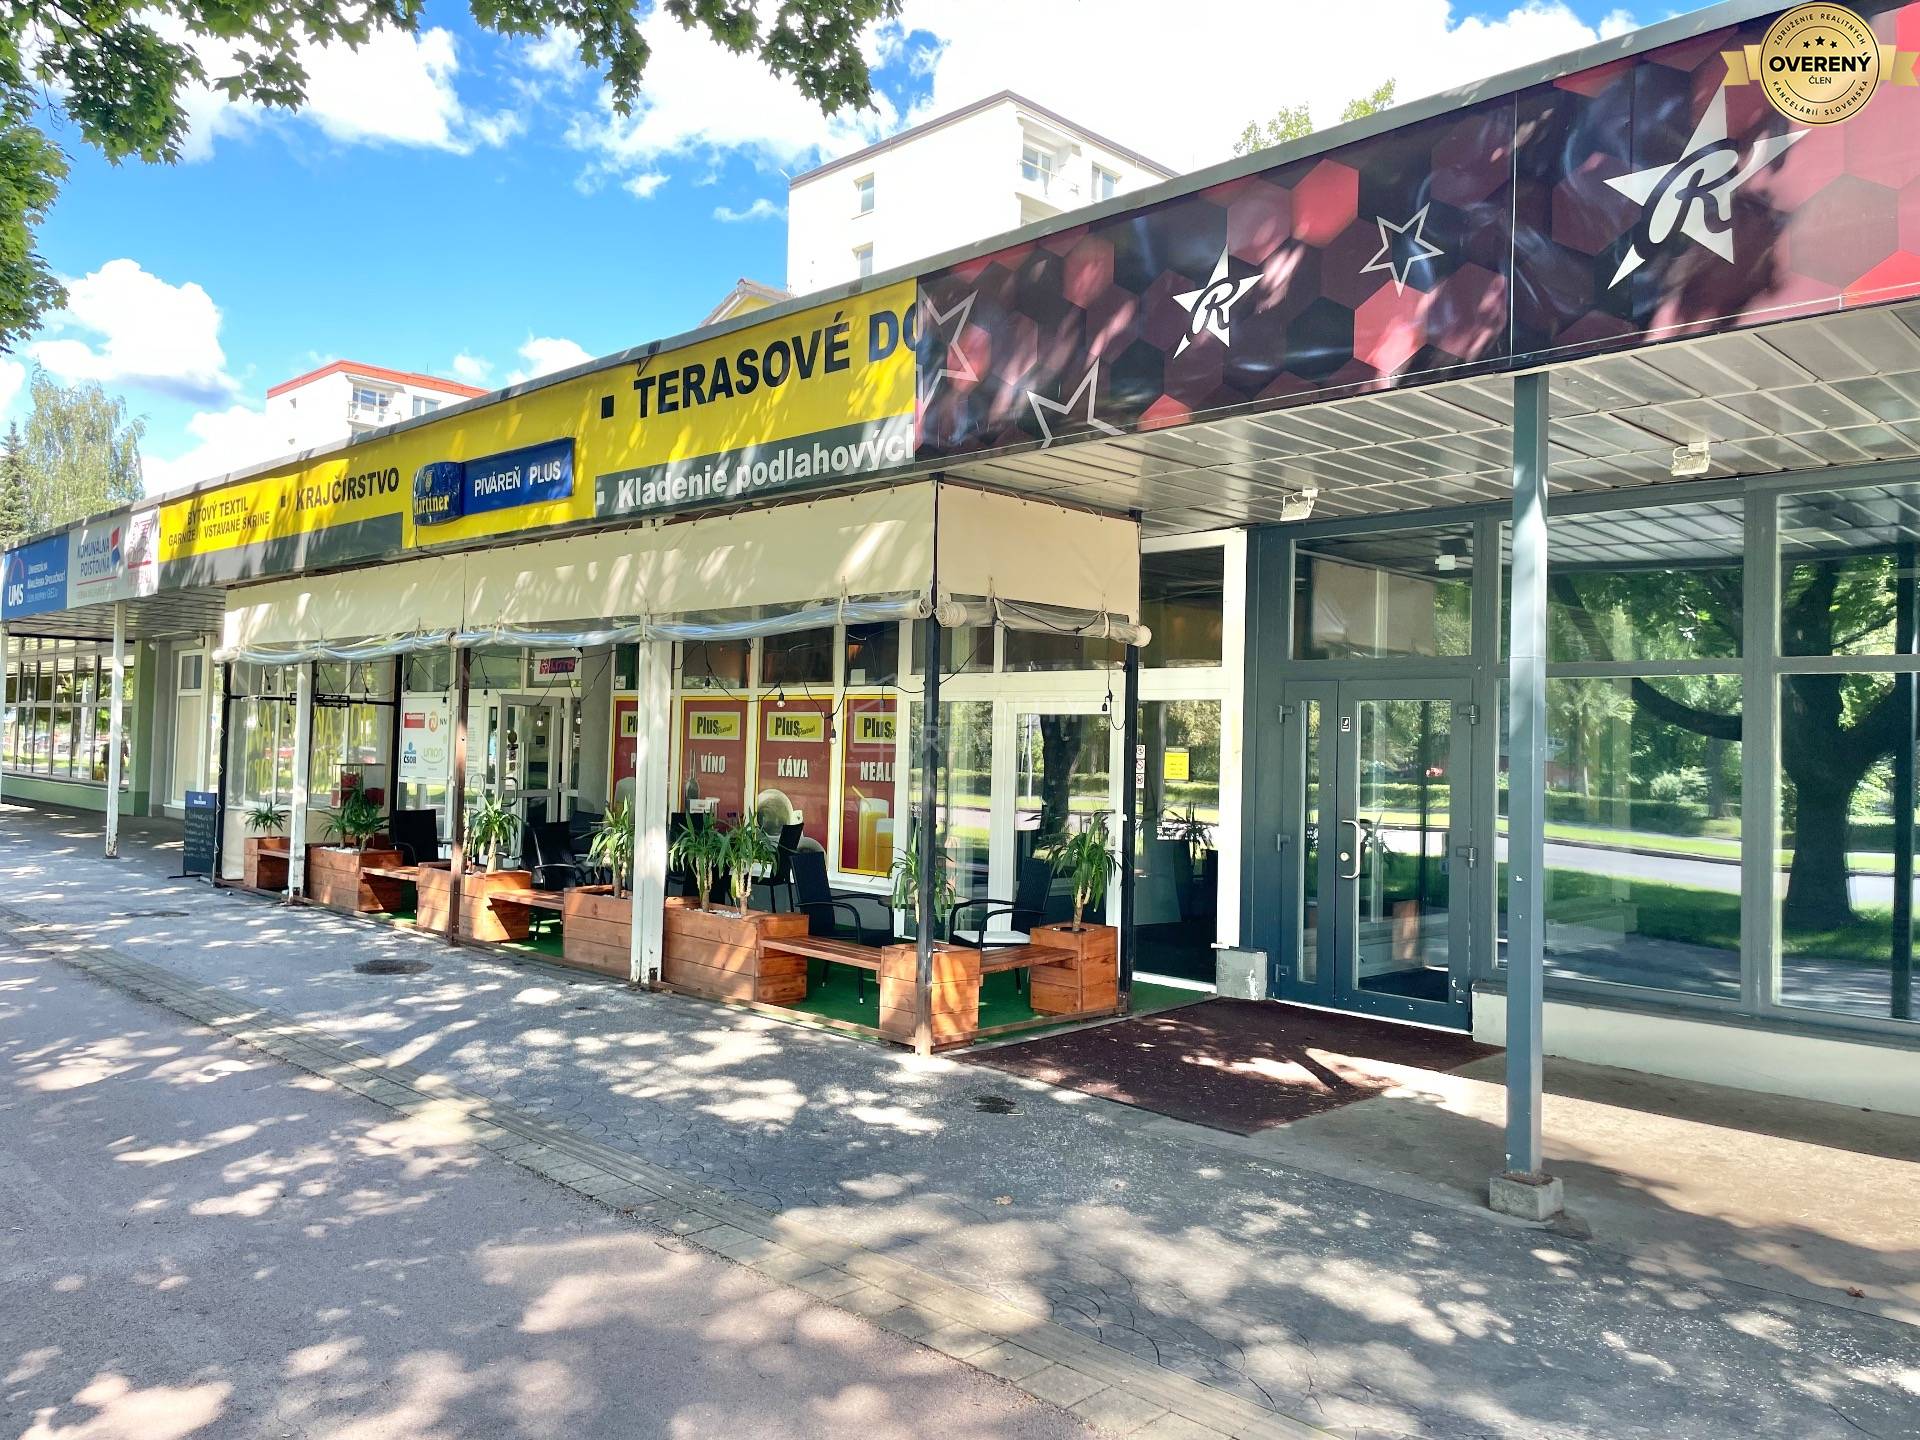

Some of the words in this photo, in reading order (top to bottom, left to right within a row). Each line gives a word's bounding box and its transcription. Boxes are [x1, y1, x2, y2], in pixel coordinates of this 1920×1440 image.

[633, 310, 850, 419] TERASOVÉ
[296, 467, 400, 512] KRAJČÍRSTVO
[474, 465, 521, 498] PIVÁREŇ
[529, 460, 561, 486] PLUS
[618, 464, 728, 509] Kladenie
[187, 500, 217, 526] BYTOVÝ
[219, 496, 249, 517] TEXTIL
[203, 515, 241, 539] VSTAVANÉ
[242, 510, 270, 530] SKRINE
[8, 583, 24, 607] UMS
[696, 716, 719, 735] Plus
[774, 717, 800, 736] Plus
[863, 717, 892, 738] Plus
[700, 751, 726, 774] VÍNO
[777, 755, 809, 778] KÁVA
